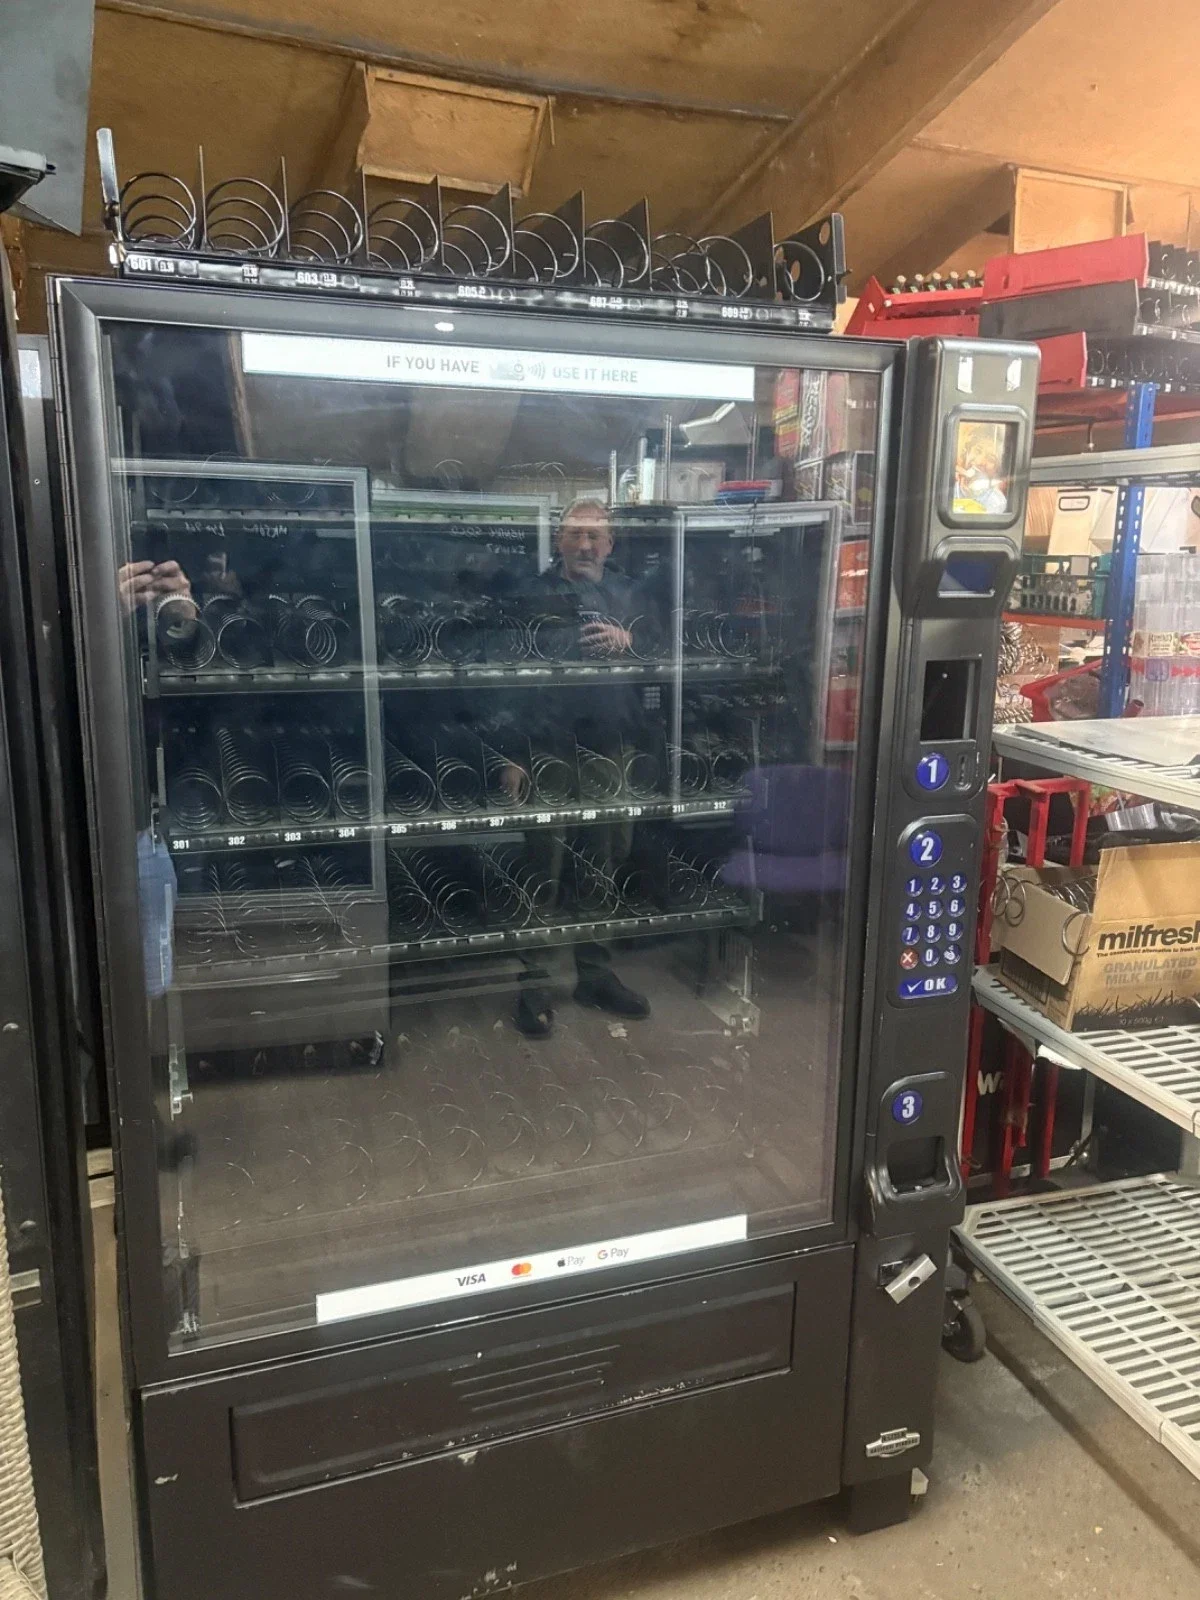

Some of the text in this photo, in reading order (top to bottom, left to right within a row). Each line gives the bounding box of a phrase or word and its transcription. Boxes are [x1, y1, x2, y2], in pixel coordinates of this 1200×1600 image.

[131, 257, 152, 271] 601
[297, 271, 318, 285] 603
[386, 354, 480, 374] IF YOU HAVE
[552, 365, 638, 383] USE IT HERE
[928, 758, 939, 784] 1
[173, 840, 190, 850] 301
[228, 836, 245, 846] 302
[284, 832, 301, 842] 303
[338, 828, 355, 838] 304
[391, 824, 407, 834] 305
[441, 820, 457, 830] 306
[490, 817, 504, 827] 307
[628, 807, 642, 817] 310
[672, 804, 686, 813] 311
[714, 801, 727, 810] 312
[920, 837, 933, 862] 2
[910, 875, 961, 892] 1 2 3
[906, 899, 958, 916] 4 5 6
[905, 923, 956, 941] 7 8 9
[925, 949, 933, 961] 0
[1104, 958, 1198, 973] GRANULATED
[924, 977, 946, 992] OK
[1105, 969, 1193, 985] MILK BLEND
[902, 1096, 915, 1119] 3
[610, 1247, 629, 1258] Pay
[567, 1255, 585, 1267] Pay
[455, 1272, 486, 1287] VISA
